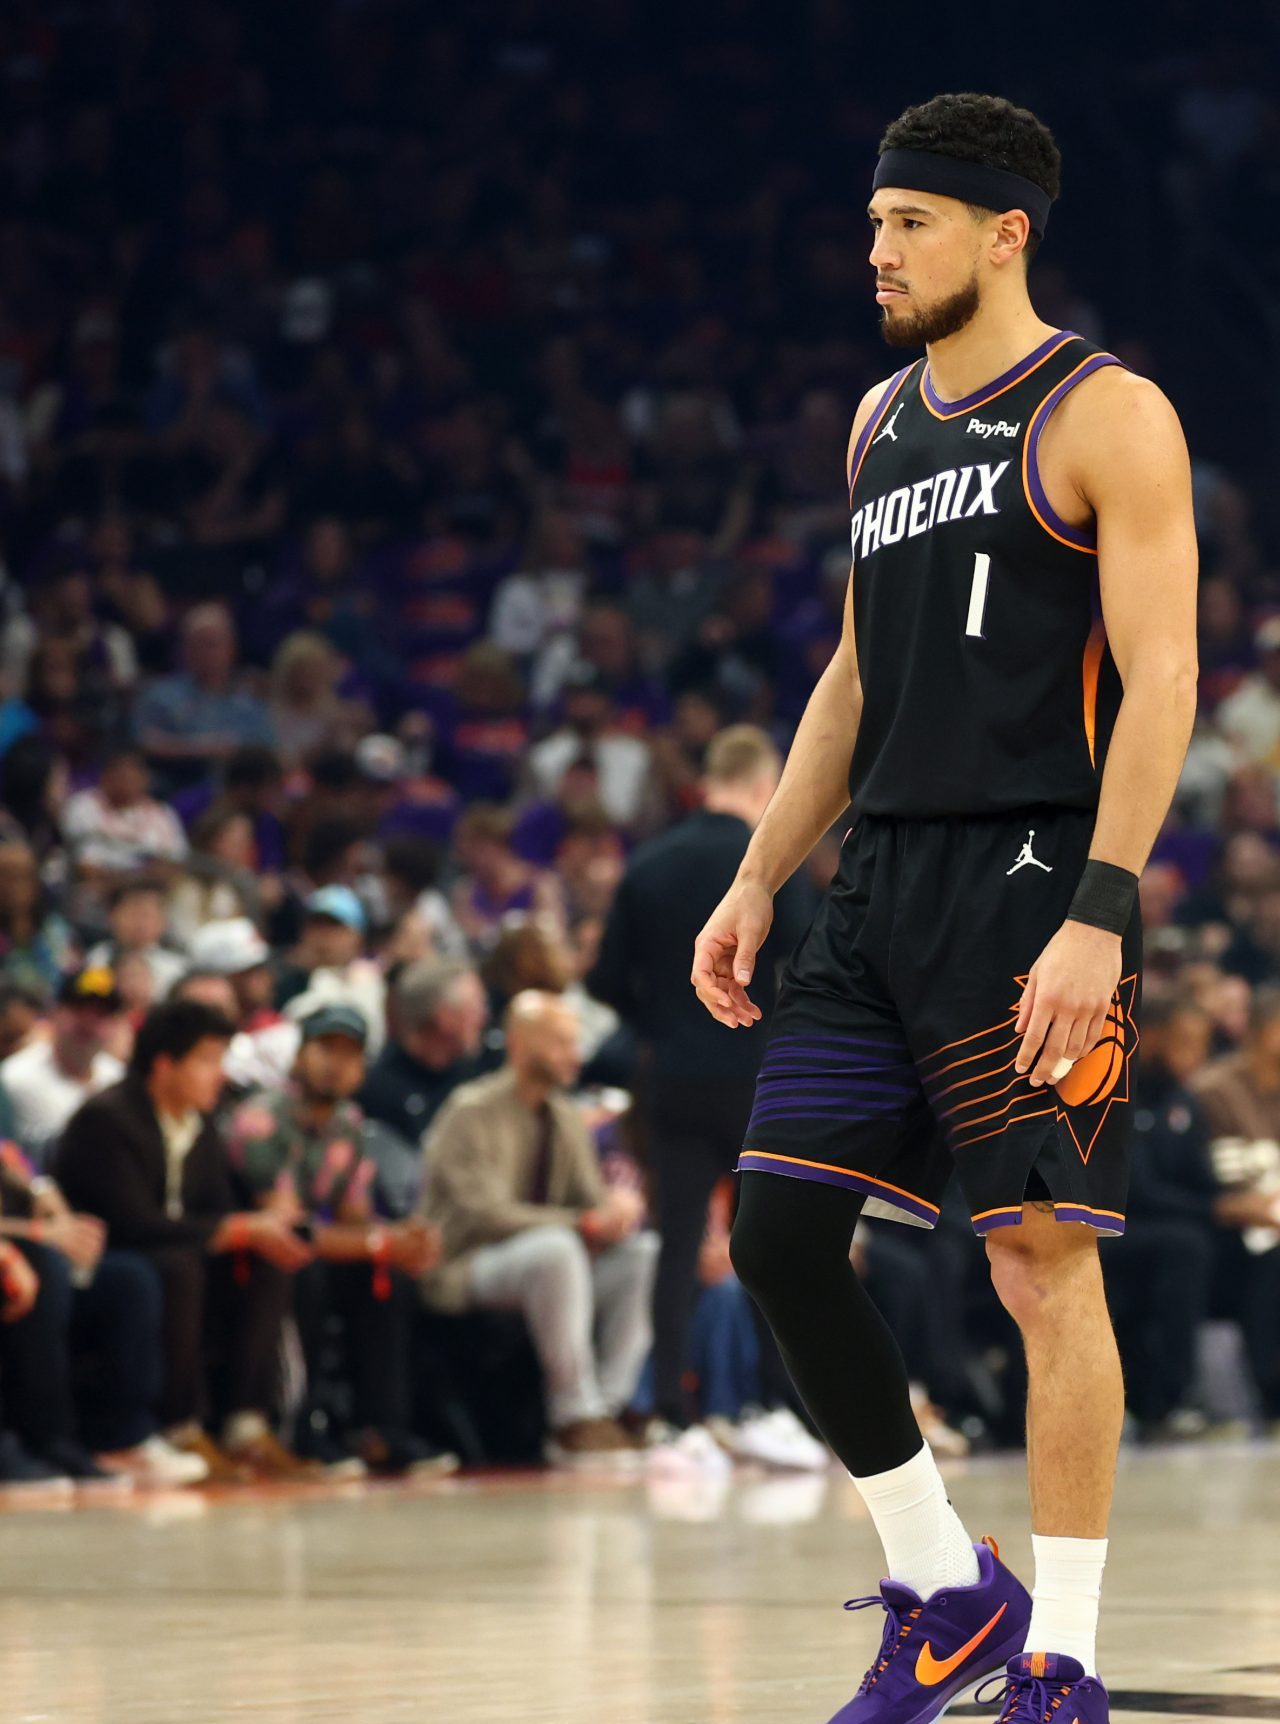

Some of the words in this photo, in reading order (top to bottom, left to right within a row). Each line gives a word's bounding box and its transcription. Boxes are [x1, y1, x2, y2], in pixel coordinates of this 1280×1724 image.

[966, 417, 1021, 439] PayPal
[851, 459, 1013, 561] PHOENIX
[965, 551, 991, 639] 1
